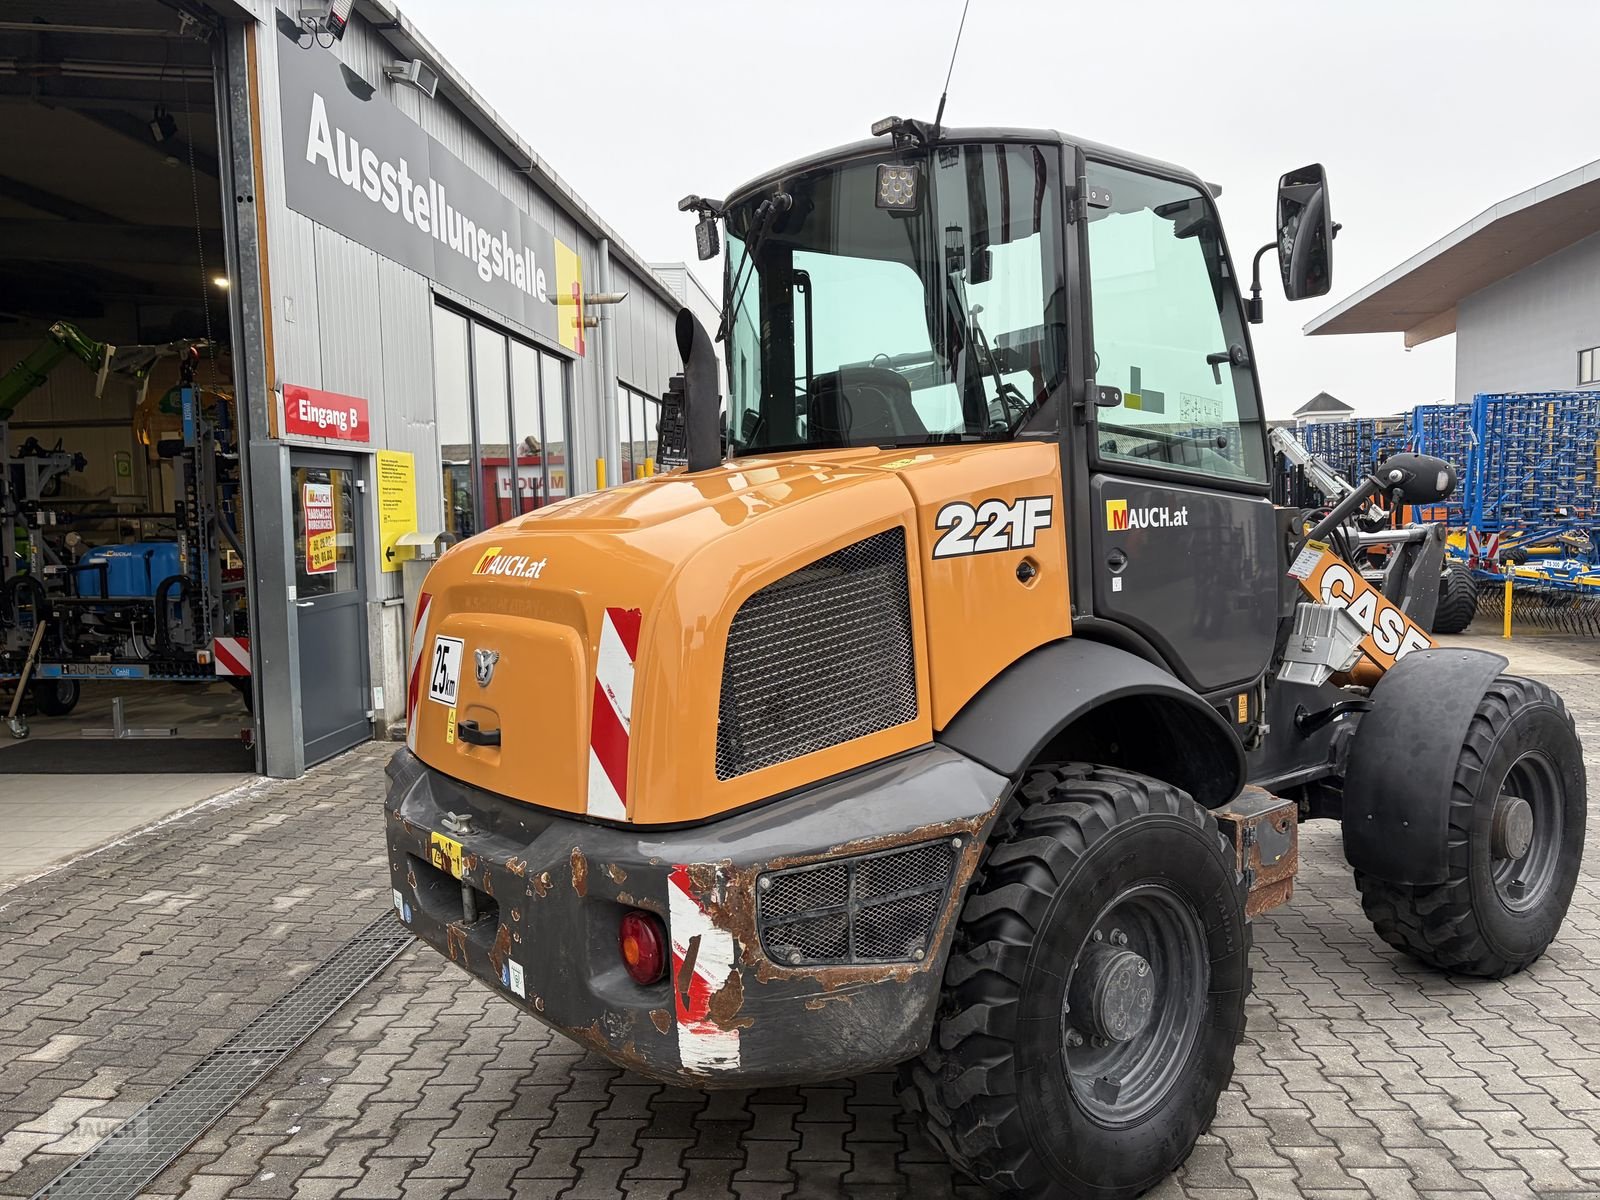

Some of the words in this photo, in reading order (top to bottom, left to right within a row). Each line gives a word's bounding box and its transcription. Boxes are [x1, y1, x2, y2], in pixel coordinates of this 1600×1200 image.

[305, 92, 548, 302] Ausstellungshalle
[298, 399, 347, 432] Eingang
[349, 408, 358, 428] B
[309, 493, 330, 503] MAUCH
[932, 495, 1053, 560] 221F
[1113, 506, 1188, 531] MAUCH.at
[479, 554, 547, 579] MAUCH.at
